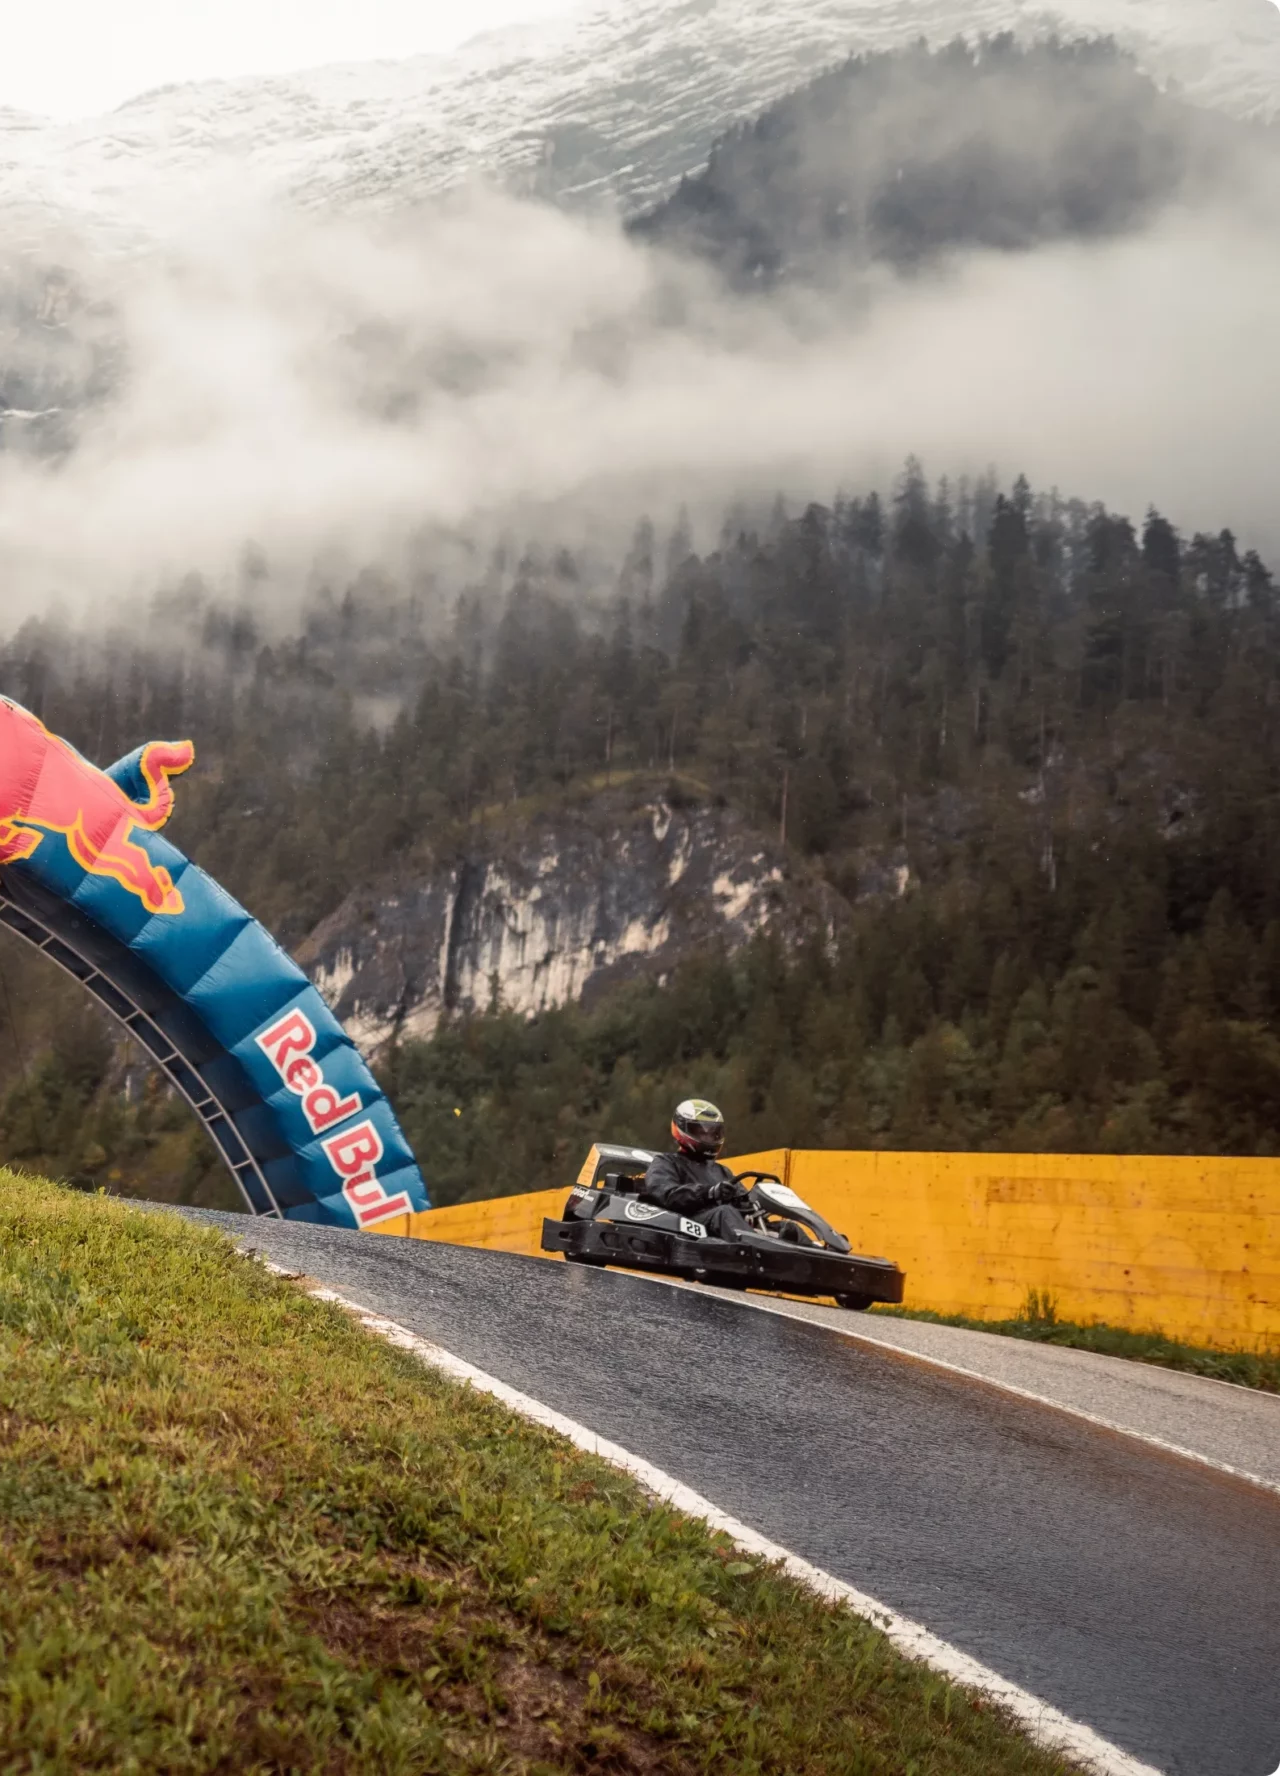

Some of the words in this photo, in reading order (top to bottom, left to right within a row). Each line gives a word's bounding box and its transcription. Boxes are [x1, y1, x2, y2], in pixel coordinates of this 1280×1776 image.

[260, 1011, 360, 1132] Red
[325, 1124, 409, 1224] Bul
[685, 1220, 703, 1237] 28
